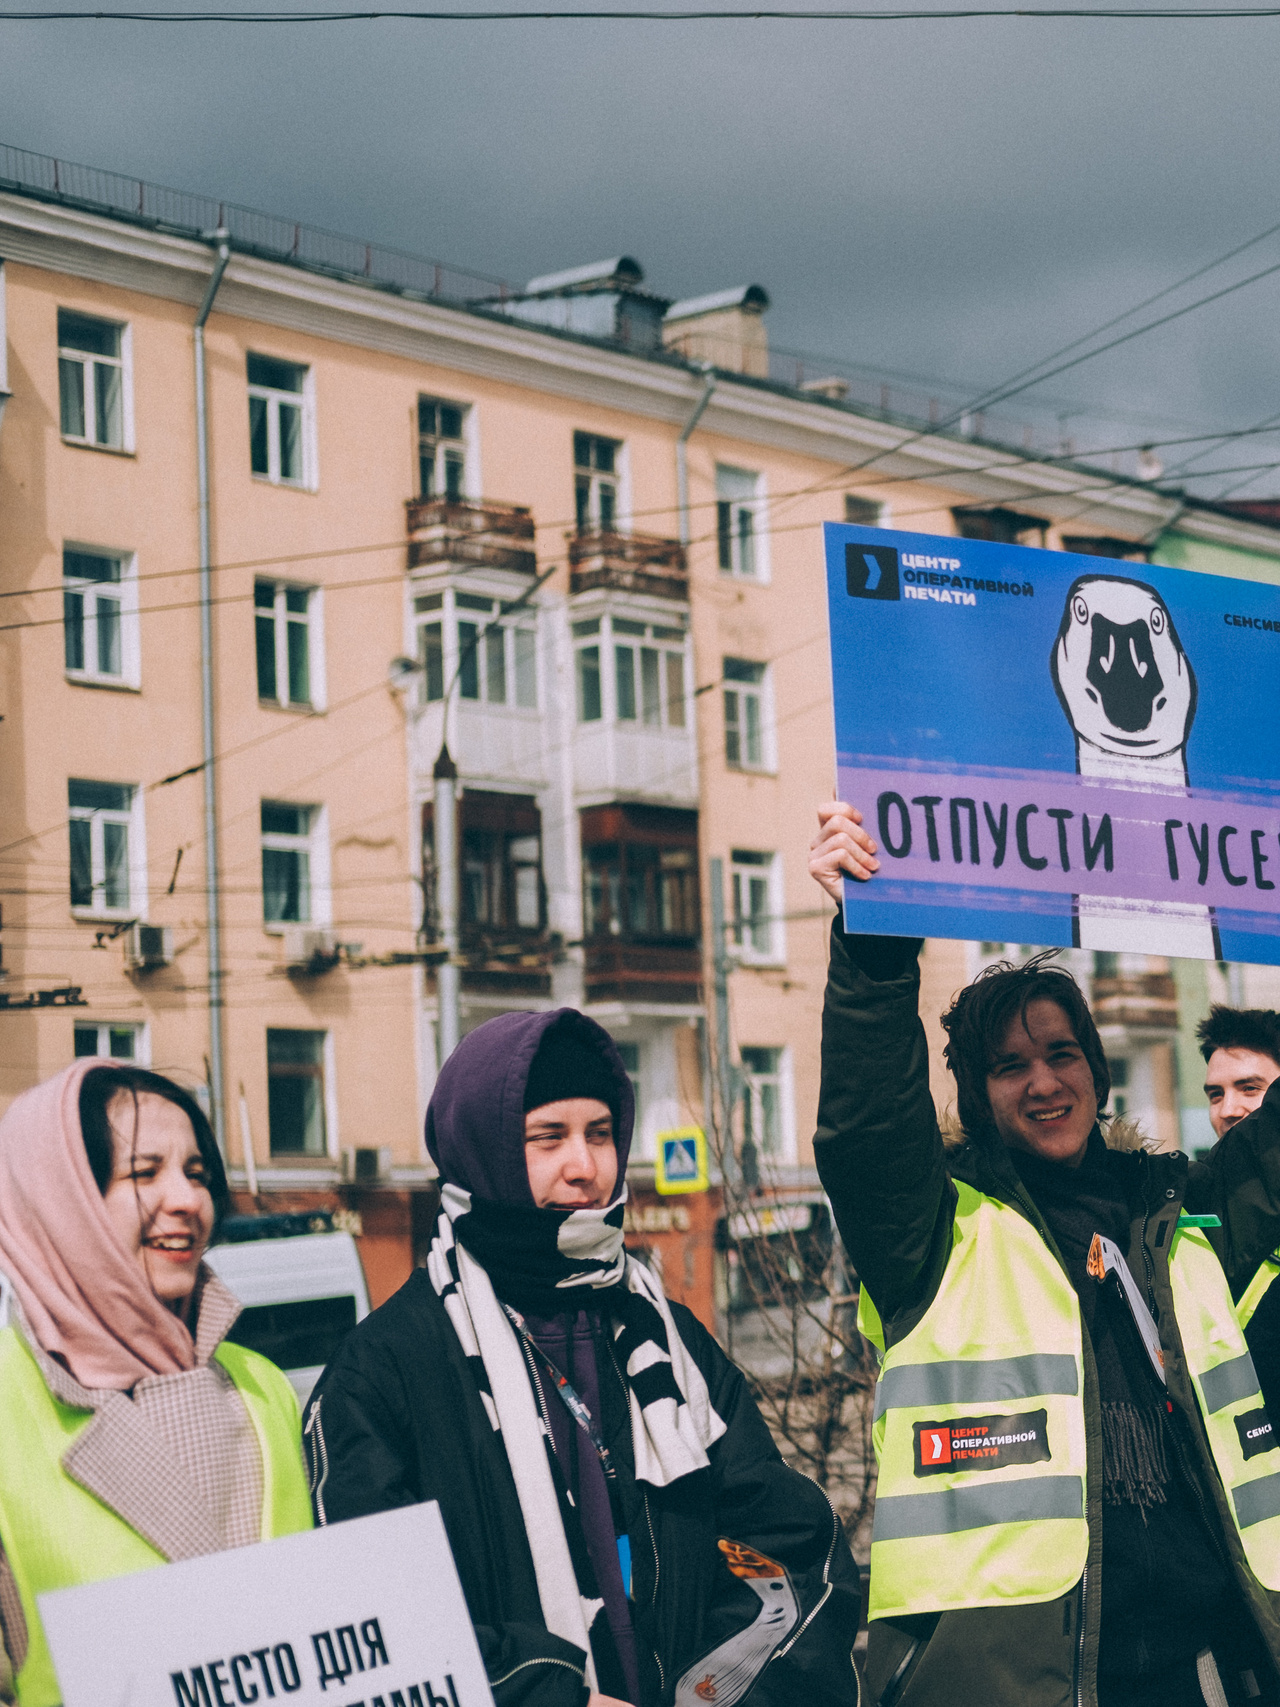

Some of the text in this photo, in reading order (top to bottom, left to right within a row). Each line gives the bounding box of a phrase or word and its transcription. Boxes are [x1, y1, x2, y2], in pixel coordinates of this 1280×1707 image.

[901, 553, 961, 571] ЦЕНТР
[903, 569, 1034, 597] ОПЕРАТИВНОЙ
[904, 585, 977, 606] ПЕЧАТИ
[877, 791, 1114, 873] ОТПУСТИ
[951, 1426, 989, 1439] ЦЕНТР
[952, 1429, 1036, 1449] ОПЕРАТИВНОЙ
[952, 1447, 998, 1460] ПЕЧАТИ
[169, 1642, 302, 1707] МЕСТО
[310, 1617, 390, 1691] ДЛЯ
